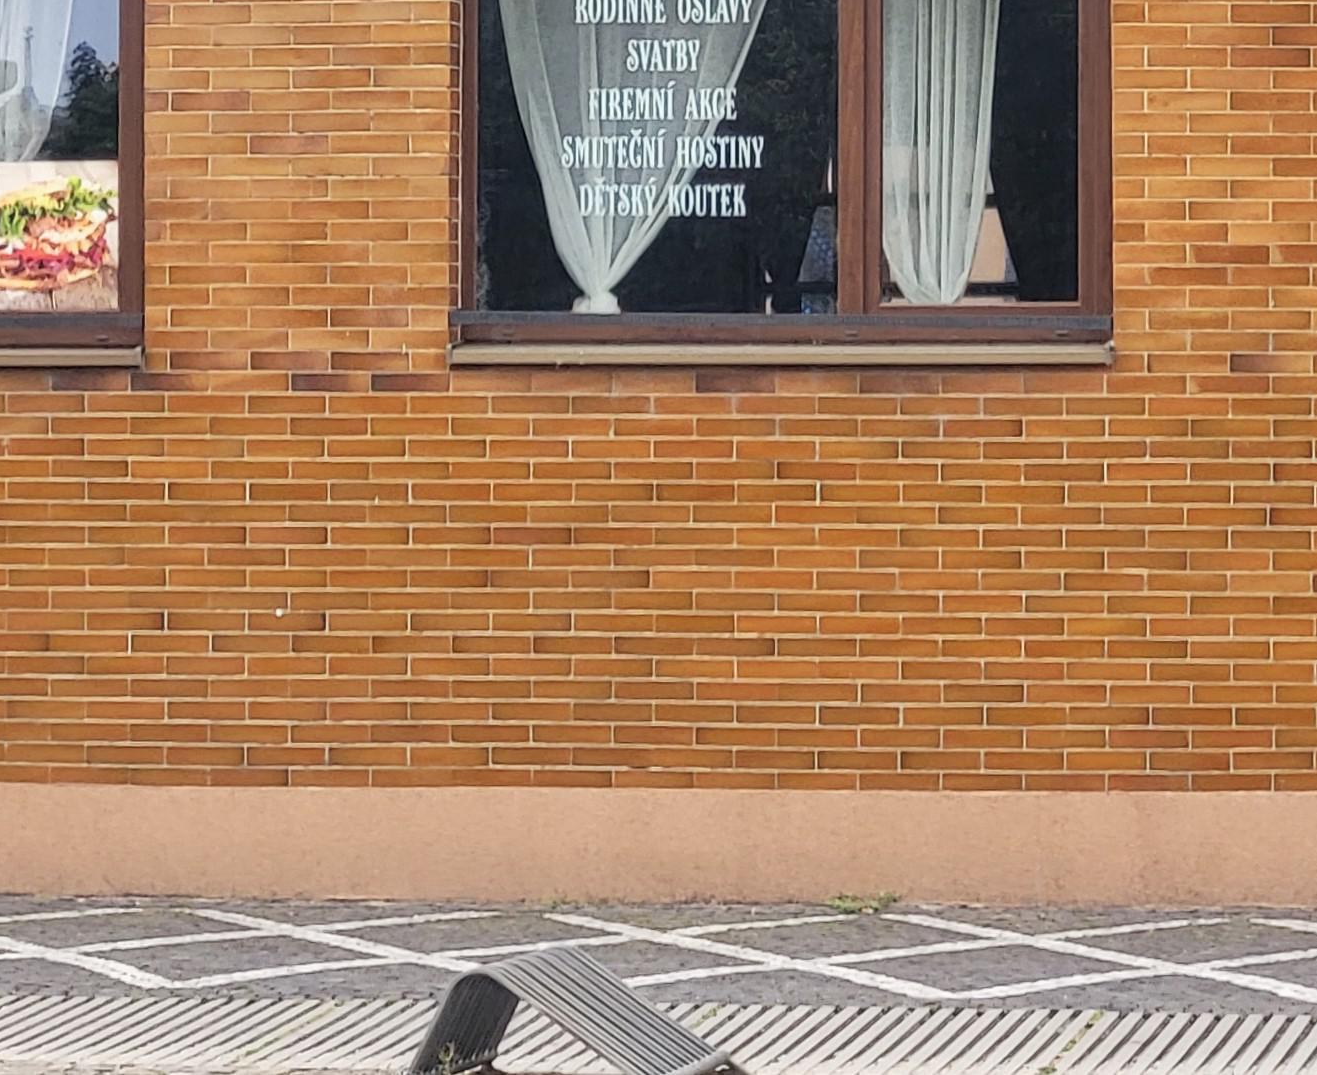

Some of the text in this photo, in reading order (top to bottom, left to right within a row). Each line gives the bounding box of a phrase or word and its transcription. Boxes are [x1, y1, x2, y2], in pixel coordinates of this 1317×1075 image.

[625, 38, 701, 72] SVATBY
[587, 80, 738, 121] FIREMNÍ AKCE
[560, 128, 765, 169] SMUTEČNÍ HOSTINY
[578, 177, 747, 217] DĚTSKÝ KOUTEK
